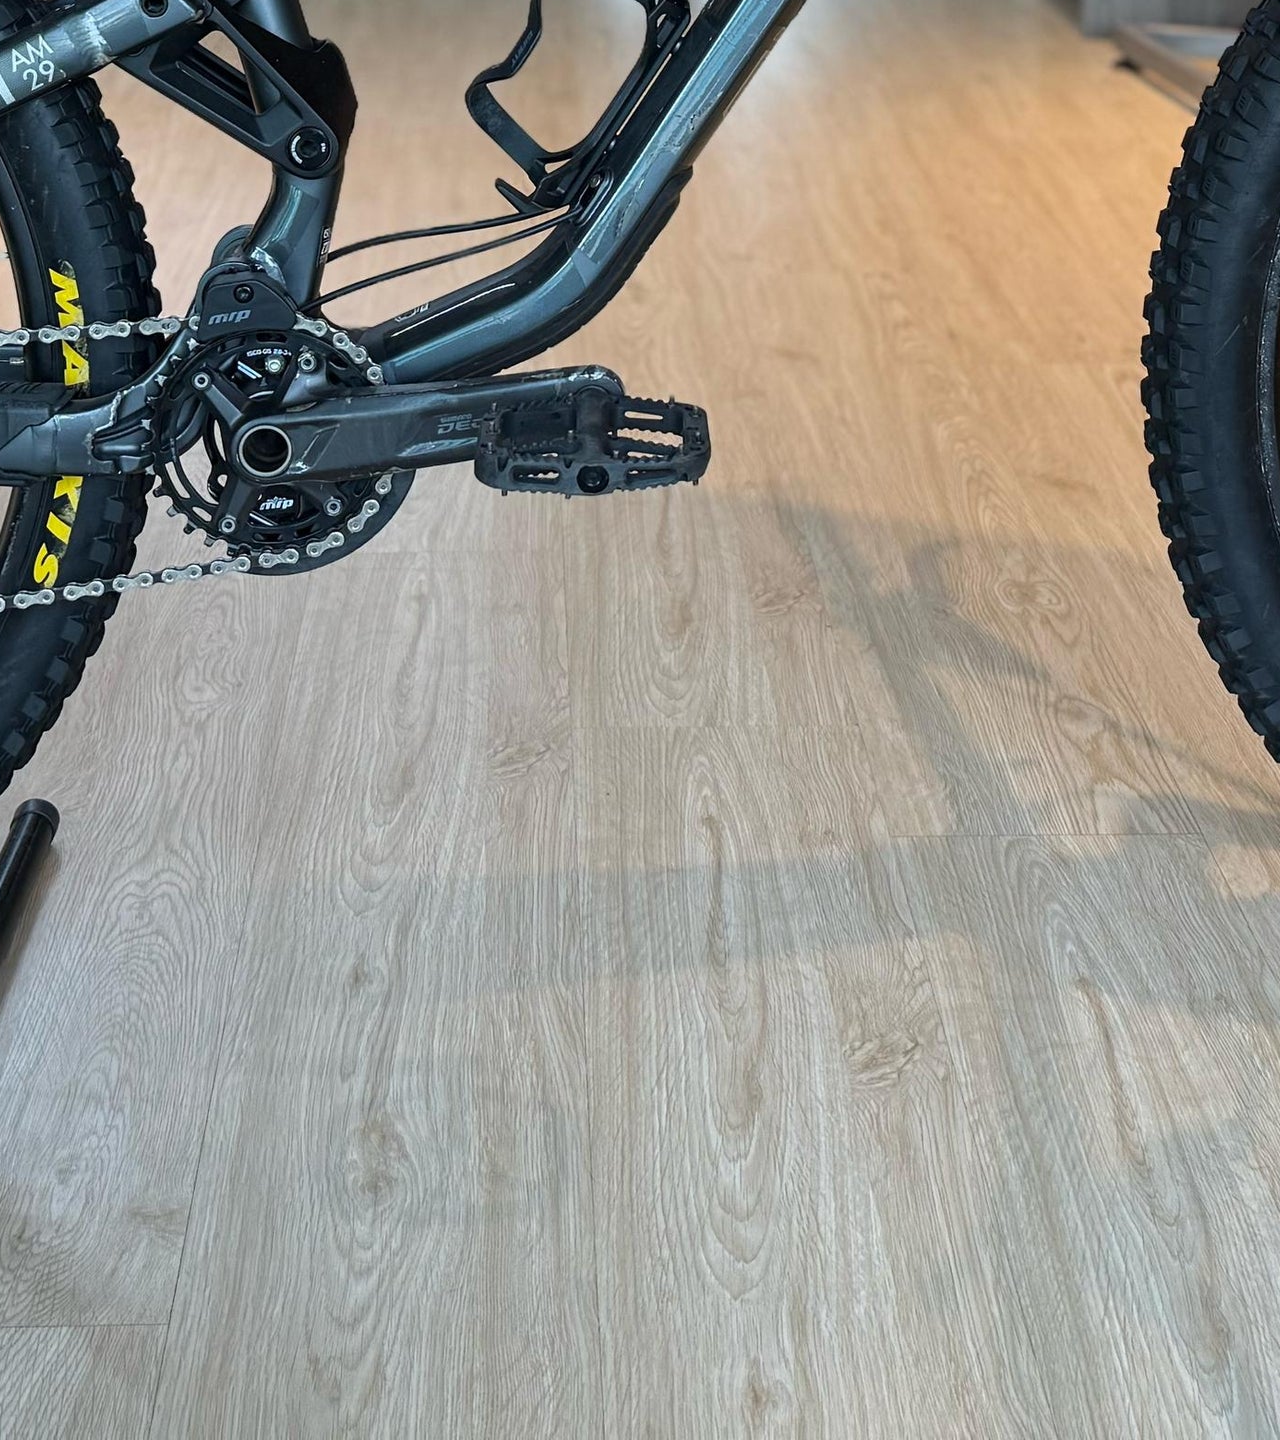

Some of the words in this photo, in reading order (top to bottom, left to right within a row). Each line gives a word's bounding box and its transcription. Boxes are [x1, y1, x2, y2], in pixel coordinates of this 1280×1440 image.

[10, 33, 55, 73] AM
[22, 60, 56, 91] 29
[208, 309, 252, 326] mrp
